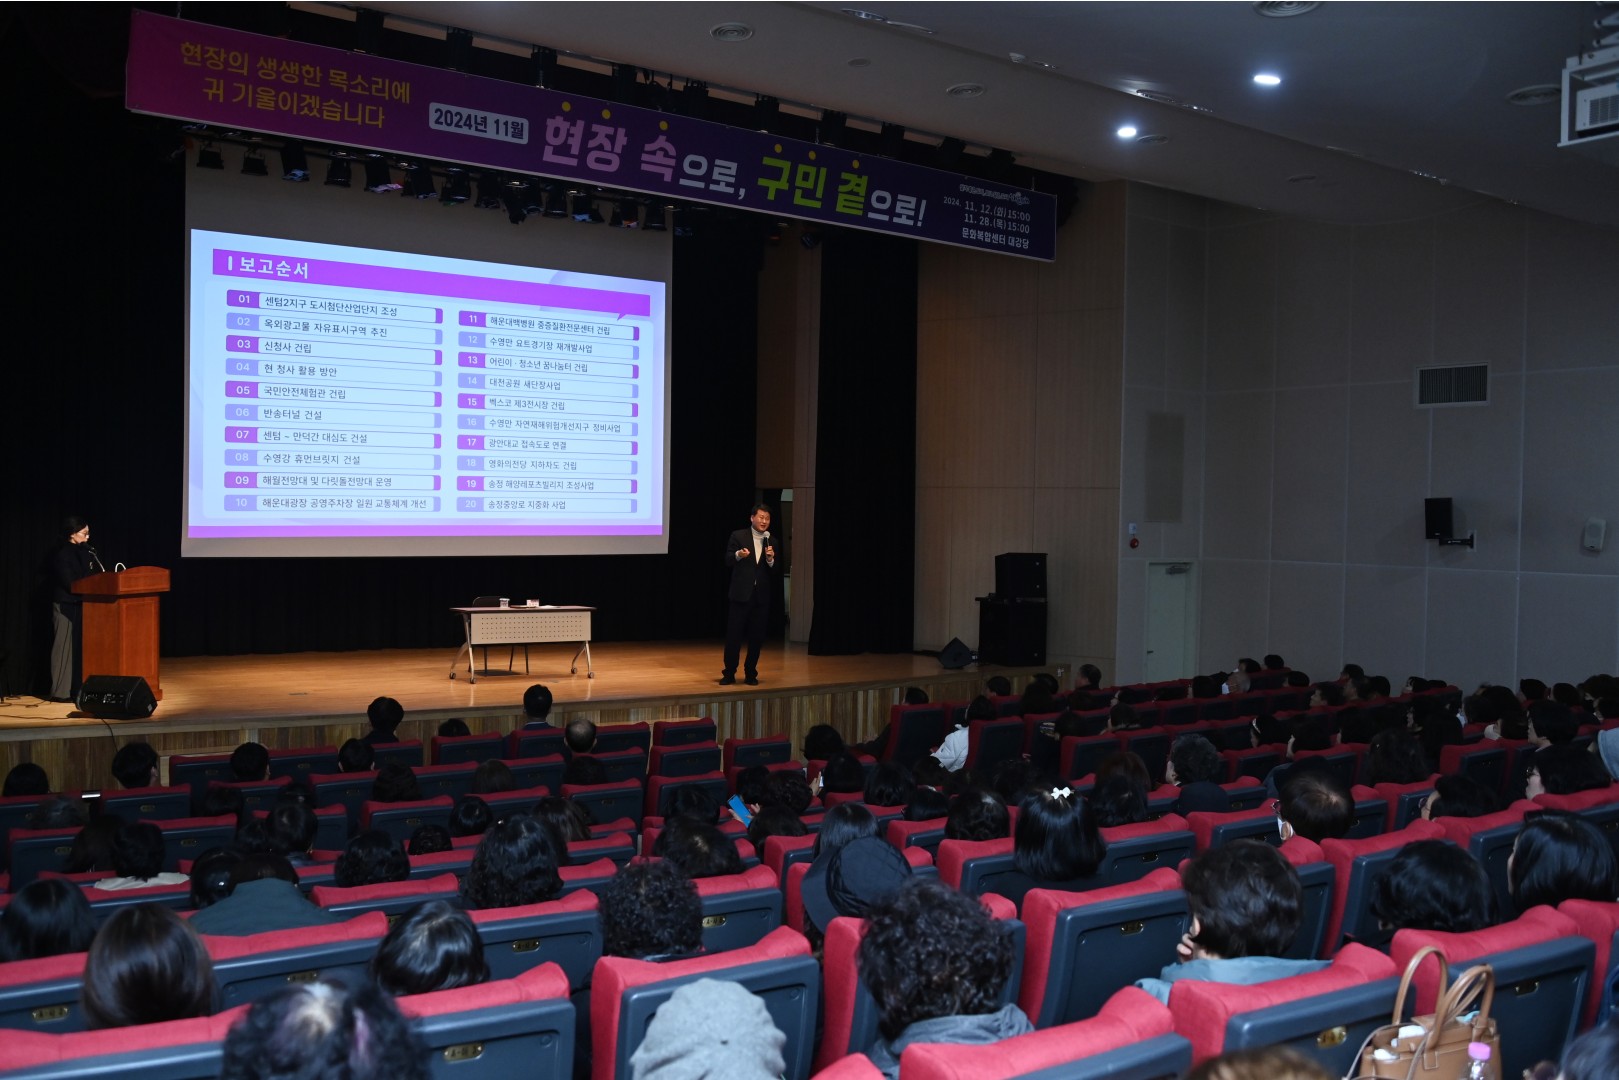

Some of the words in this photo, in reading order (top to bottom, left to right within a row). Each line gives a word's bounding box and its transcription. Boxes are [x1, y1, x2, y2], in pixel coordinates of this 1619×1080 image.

[180, 41, 249, 76] 현장의
[256, 56, 322, 87] 생생한
[329, 68, 411, 104] 목소리에
[203, 77, 224, 103] 귀
[233, 84, 385, 129] 기울이겠습니다
[434, 108, 488, 133] 2024년
[494, 119, 524, 140] 11월
[542, 114, 628, 173] 현장
[640, 135, 747, 200] 속으로,
[757, 156, 827, 209] 구민
[836, 172, 927, 227] 곁으로!
[944, 196, 961, 206] 2024.
[965, 201, 977, 212] 11.
[1008, 210, 1030, 221] 15:00
[964, 214, 977, 224] 11.
[1008, 222, 1030, 234] 15:00
[962, 228, 1006, 245] 문화복합센터
[1008, 237, 1030, 249] 대강당
[240, 256, 309, 279] 보고순서
[238, 294, 250, 304] 01
[265, 296, 307, 309] 센텀2지구
[310, 300, 378, 315] 도시첨단산업단지
[381, 306, 397, 317] 조성
[237, 317, 250, 326] 02
[264, 319, 310, 332] 옥외광고물
[314, 323, 367, 336] 자유표시구역
[370, 328, 387, 337] 추진
[490, 317, 535, 328] 해운대백병원
[538, 321, 594, 334] 중증질환전문센터
[597, 326, 610, 335] 건립
[237, 340, 251, 349] 03
[264, 341, 291, 352] 신청사
[294, 343, 312, 354] 건립
[490, 338, 513, 348] 수영만
[516, 339, 553, 350] 요트경기장
[556, 343, 592, 353] 재개발사업
[236, 363, 250, 371] 04
[264, 364, 273, 374] 현
[277, 365, 295, 375] 청사
[298, 366, 316, 376] 활용
[319, 367, 337, 377] 방안
[468, 356, 478, 364] 13
[490, 358, 512, 367] 어린이
[519, 359, 541, 370] 청소년
[543, 361, 572, 371] 꿈나눔터
[574, 364, 588, 373] 건립
[490, 378, 520, 388] 대천공원
[523, 380, 561, 390] 새단장사업
[236, 386, 250, 395] 05
[264, 386, 326, 399] 국민안전체험관
[329, 389, 346, 399] 건립
[468, 398, 476, 406] 15
[489, 398, 512, 407] 벡스코
[514, 399, 549, 410] 제3전시장
[551, 401, 565, 410] 건립
[235, 408, 249, 417] 06
[264, 409, 300, 419] 반송터널
[304, 410, 322, 420] 건설
[489, 419, 512, 428] 수영만
[515, 421, 589, 431] 자연재해위험개선지구
[593, 424, 621, 433] 정비사업
[236, 431, 249, 439] 07
[264, 430, 281, 440] 센텀
[293, 432, 319, 442] 만덕간
[322, 432, 348, 442] 대심도
[350, 433, 367, 443] 건설
[489, 439, 518, 448] 광안대교
[521, 440, 550, 449] 접속도로
[552, 441, 567, 450] 연결
[235, 453, 249, 461] 08
[263, 453, 291, 463] 수영강
[295, 454, 339, 464] 휴먼브릿지
[343, 455, 360, 465] 건설
[489, 460, 527, 469] 영화의전당
[530, 461, 559, 469] 지하차도
[562, 461, 577, 470] 건립
[235, 476, 249, 485] 09
[262, 476, 307, 486] 해월전망대
[311, 477, 319, 486] 및
[322, 477, 373, 487] 다릿돌전망대
[376, 477, 392, 487] 운영
[488, 480, 503, 489] 송정
[505, 480, 564, 490] 해양레포츠빌리지
[566, 481, 594, 490] 조성사업
[236, 498, 247, 507] 10
[262, 498, 307, 509] 해운대광장
[311, 498, 353, 509] 공영주차장
[356, 499, 372, 508] 일원
[375, 499, 408, 509] 교통체계
[410, 499, 427, 509] 개선
[488, 500, 525, 509] 송정중앙로
[528, 501, 549, 509] 지중화
[552, 501, 566, 509] 사업
